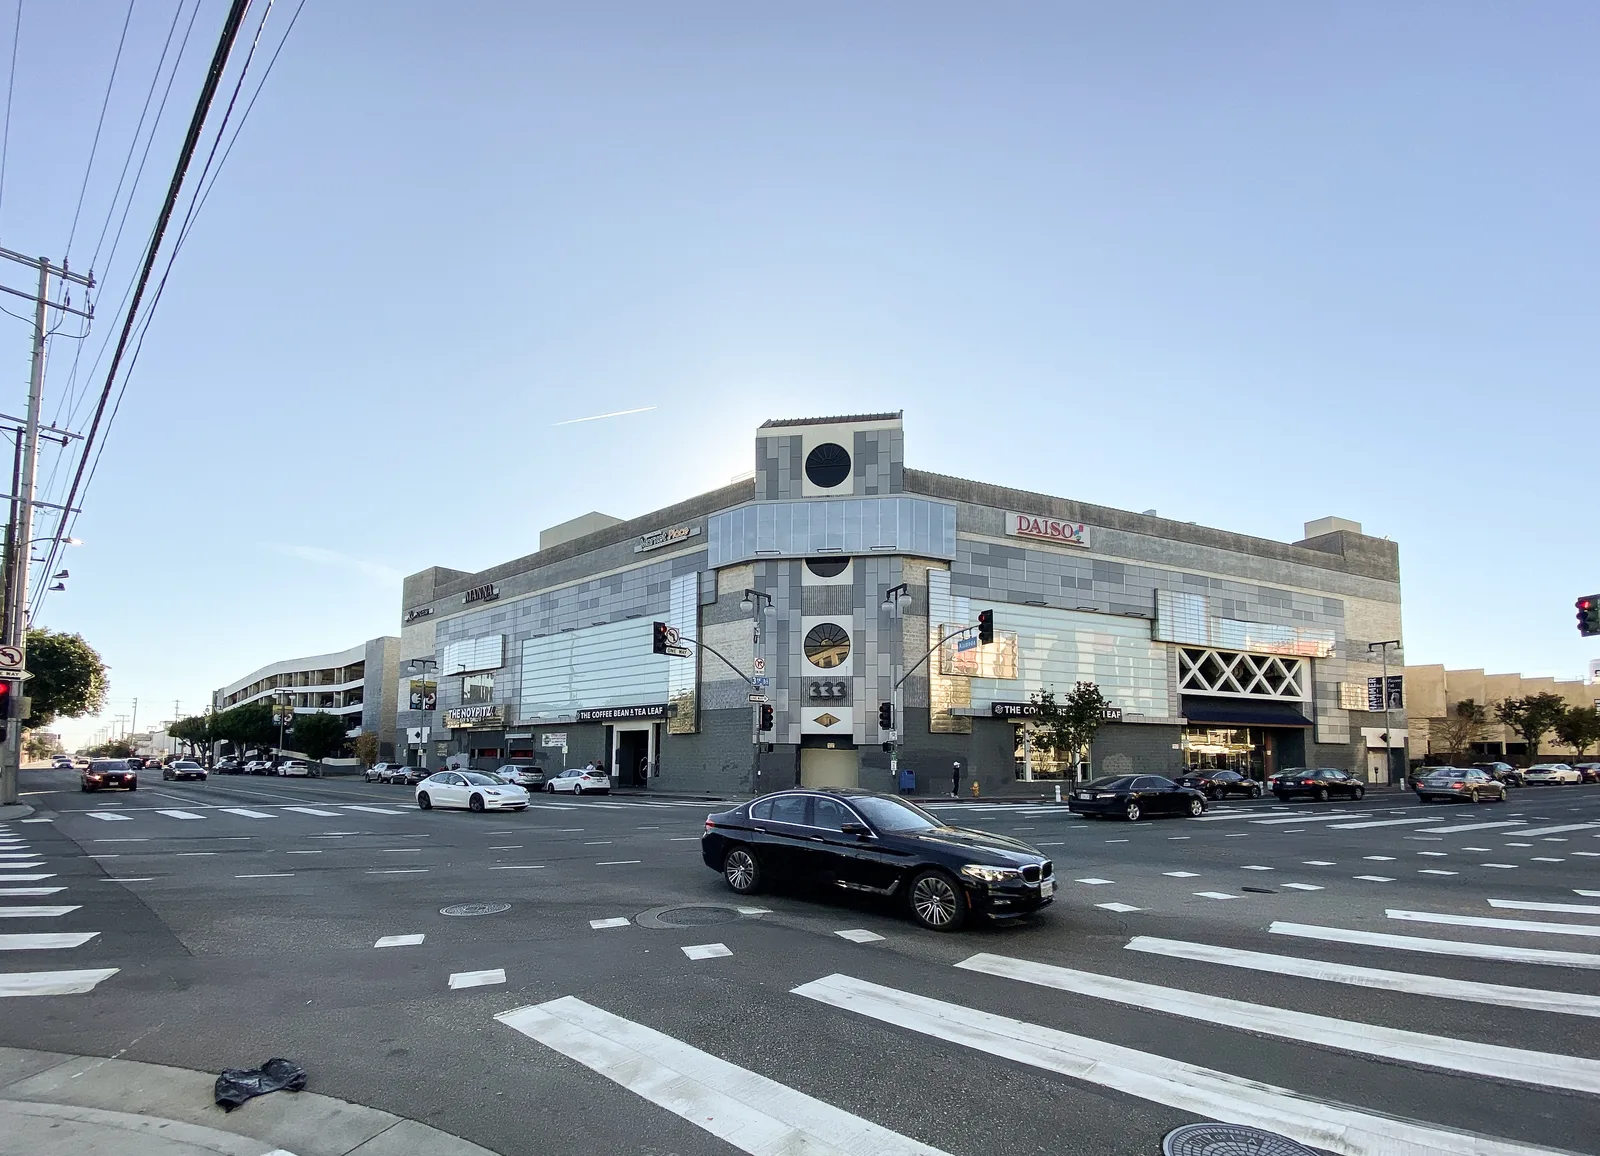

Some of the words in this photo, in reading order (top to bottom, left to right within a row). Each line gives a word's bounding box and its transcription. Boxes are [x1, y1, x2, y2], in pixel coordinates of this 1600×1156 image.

[1016, 515, 1074, 539] DAISO
[809, 681, 848, 701] 333
[1369, 678, 1377, 710] HAMMER
[448, 709, 460, 719] THE
[581, 711, 591, 719] THE
[591, 710, 613, 719] COFFEE
[613, 709, 630, 717] BEAN
[634, 708, 647, 716] TEA
[647, 706, 663, 715] LEAF
[1004, 705, 1021, 714] THE
[1189, 1134, 1215, 1147] CITY
